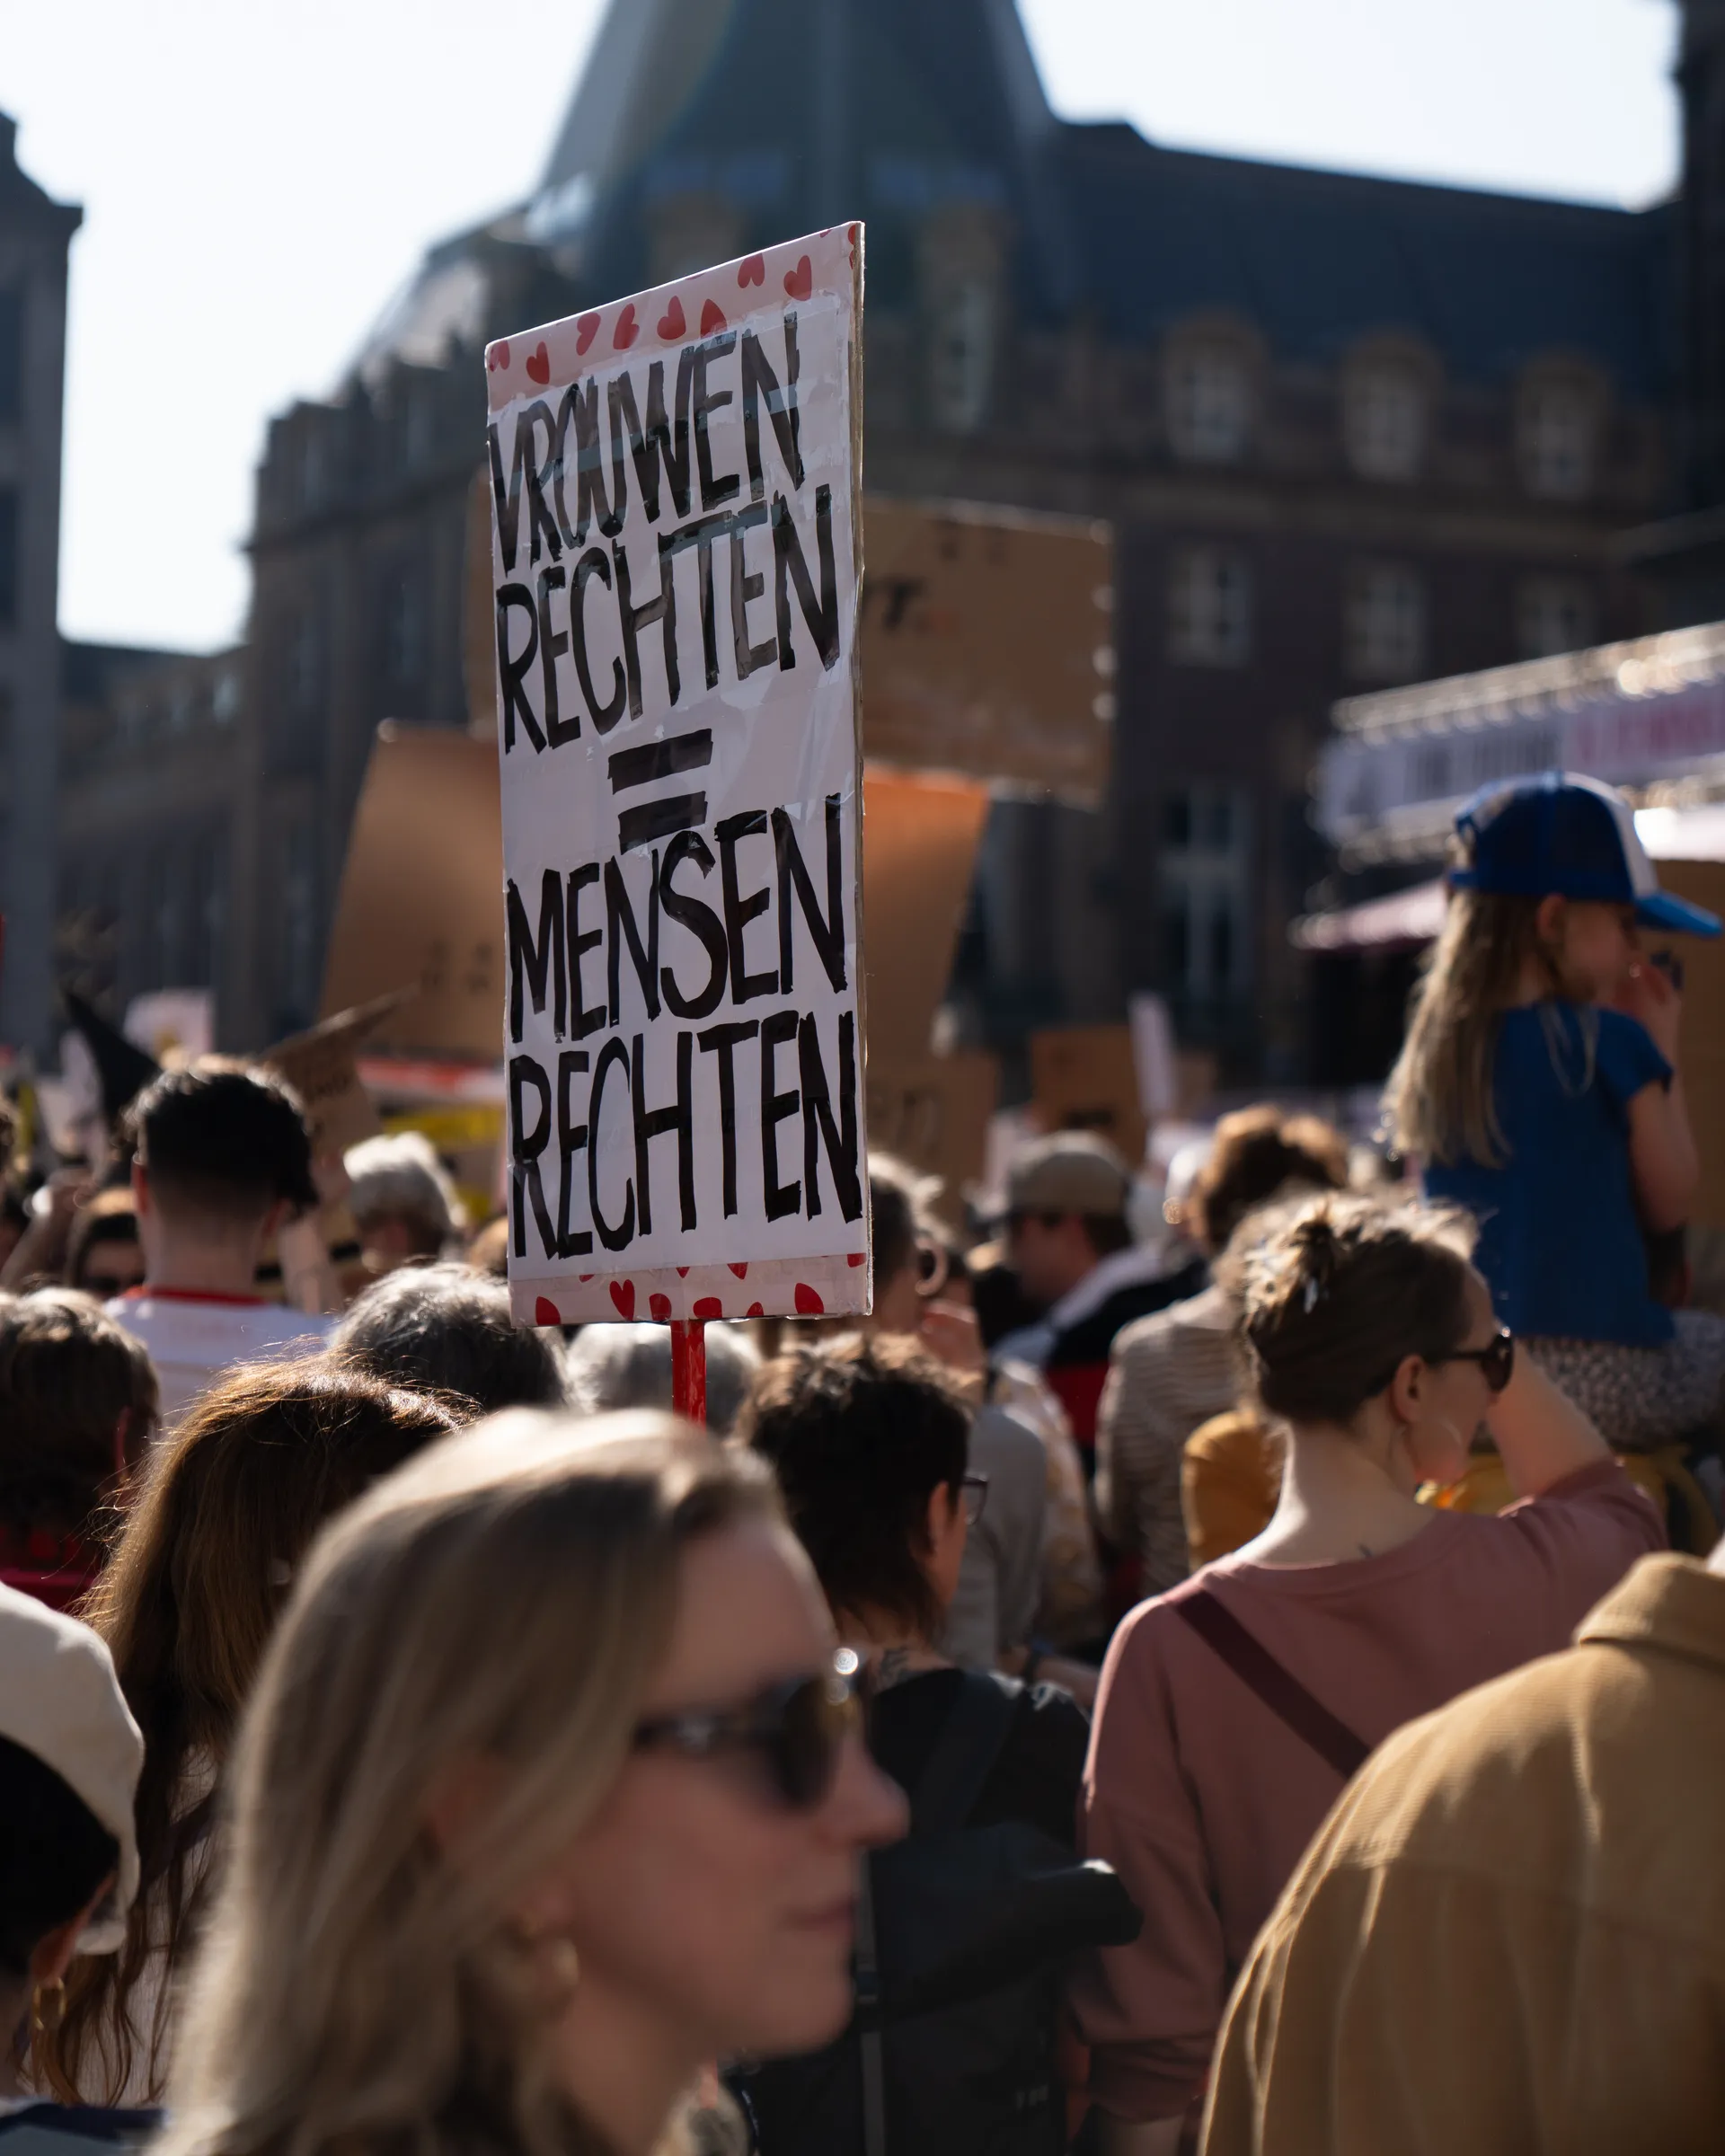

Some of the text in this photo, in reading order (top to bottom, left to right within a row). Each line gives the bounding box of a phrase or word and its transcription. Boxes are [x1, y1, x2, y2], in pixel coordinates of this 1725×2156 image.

[489, 312, 805, 578] VROUWEN
[496, 483, 840, 755] RECHTEN
[508, 792, 847, 1044] MENSEN
[509, 1011, 862, 1259] RECHTEN
